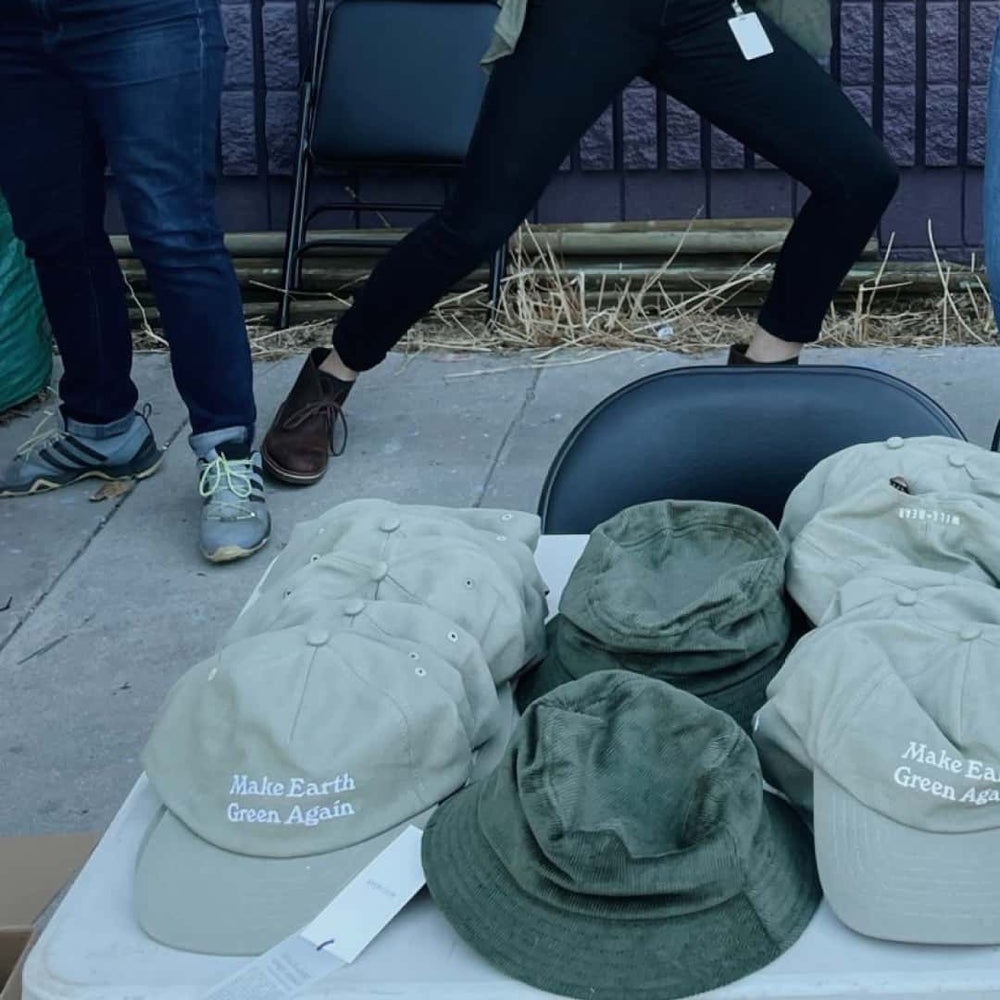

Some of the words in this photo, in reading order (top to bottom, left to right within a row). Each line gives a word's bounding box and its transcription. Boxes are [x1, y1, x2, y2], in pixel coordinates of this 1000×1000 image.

[901, 741, 963, 773] Make
[229, 774, 284, 796] Make
[286, 772, 356, 797] Earth
[893, 765, 956, 801] Green
[227, 801, 281, 823] Green
[283, 799, 355, 827] Again
